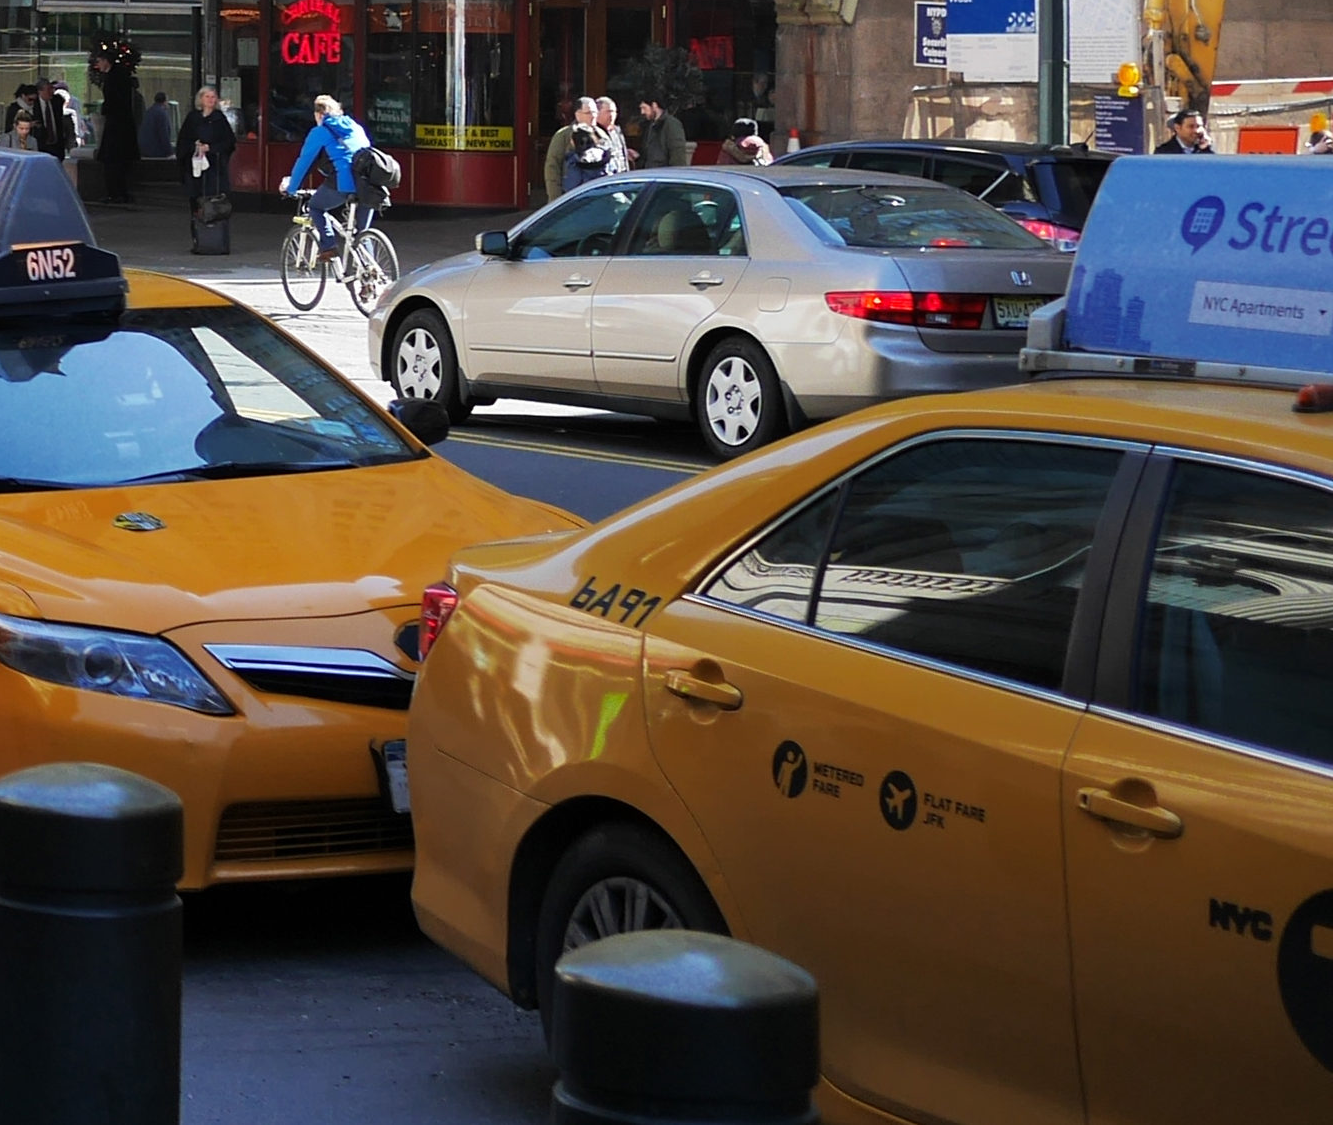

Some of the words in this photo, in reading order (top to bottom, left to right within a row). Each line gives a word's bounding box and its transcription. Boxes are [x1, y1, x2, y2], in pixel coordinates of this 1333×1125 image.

[281, 32, 341, 64] CAFE
[424, 128, 435, 137] THE
[471, 129, 478, 137] &
[480, 128, 499, 137] BEST
[466, 139, 488, 148] NEW
[488, 139, 511, 148] YORK
[1227, 201, 1333, 257] Stre
[26, 247, 77, 282] 6N52
[1202, 295, 1229, 313] NYC
[1230, 299, 1306, 319] Apartments
[568, 576, 662, 629] 6A91
[812, 778, 841, 799] FARE
[813, 761, 865, 788] METERED
[923, 792, 952, 814] FLAT
[954, 800, 987, 824] FARE
[923, 811, 945, 830] JFK
[1208, 897, 1274, 942] NYC
